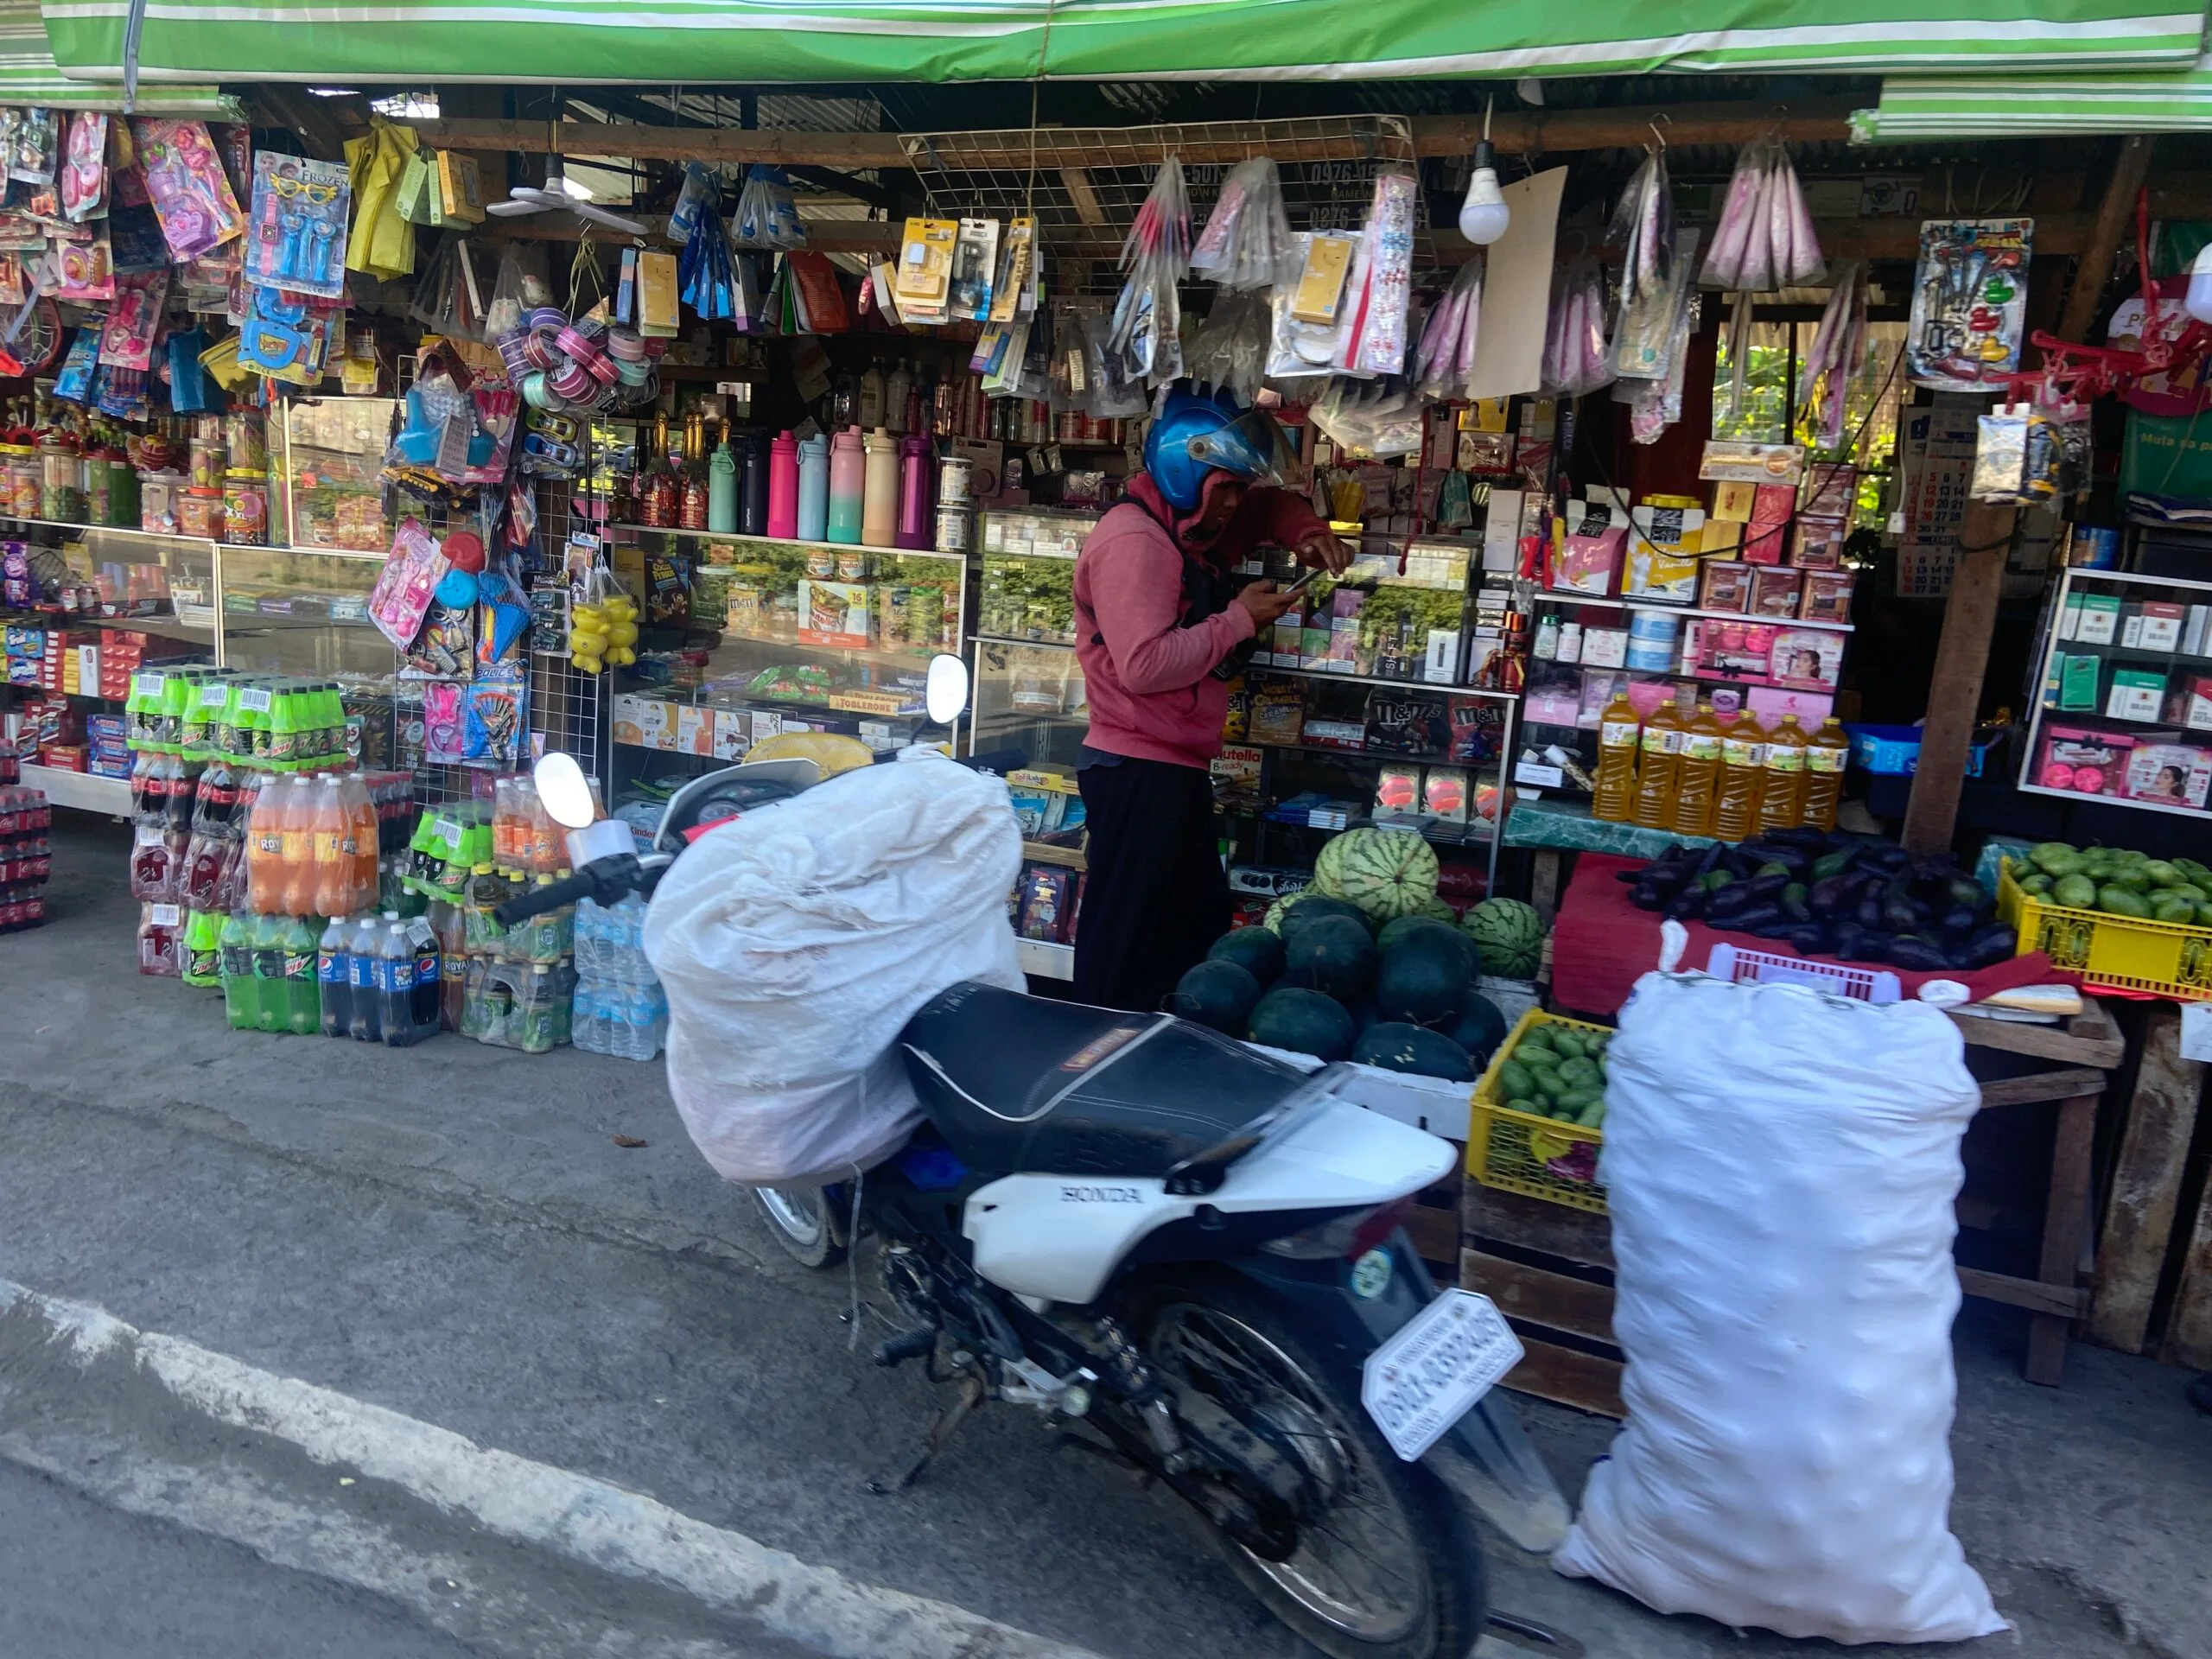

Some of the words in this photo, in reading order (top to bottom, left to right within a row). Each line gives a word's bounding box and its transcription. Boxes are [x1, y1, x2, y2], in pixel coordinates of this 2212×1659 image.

[301, 169, 349, 188] FROZEN
[839, 698, 891, 713] TOBLERONE
[1219, 747, 1262, 762] utella
[1059, 1185, 1145, 1204] HONDA
